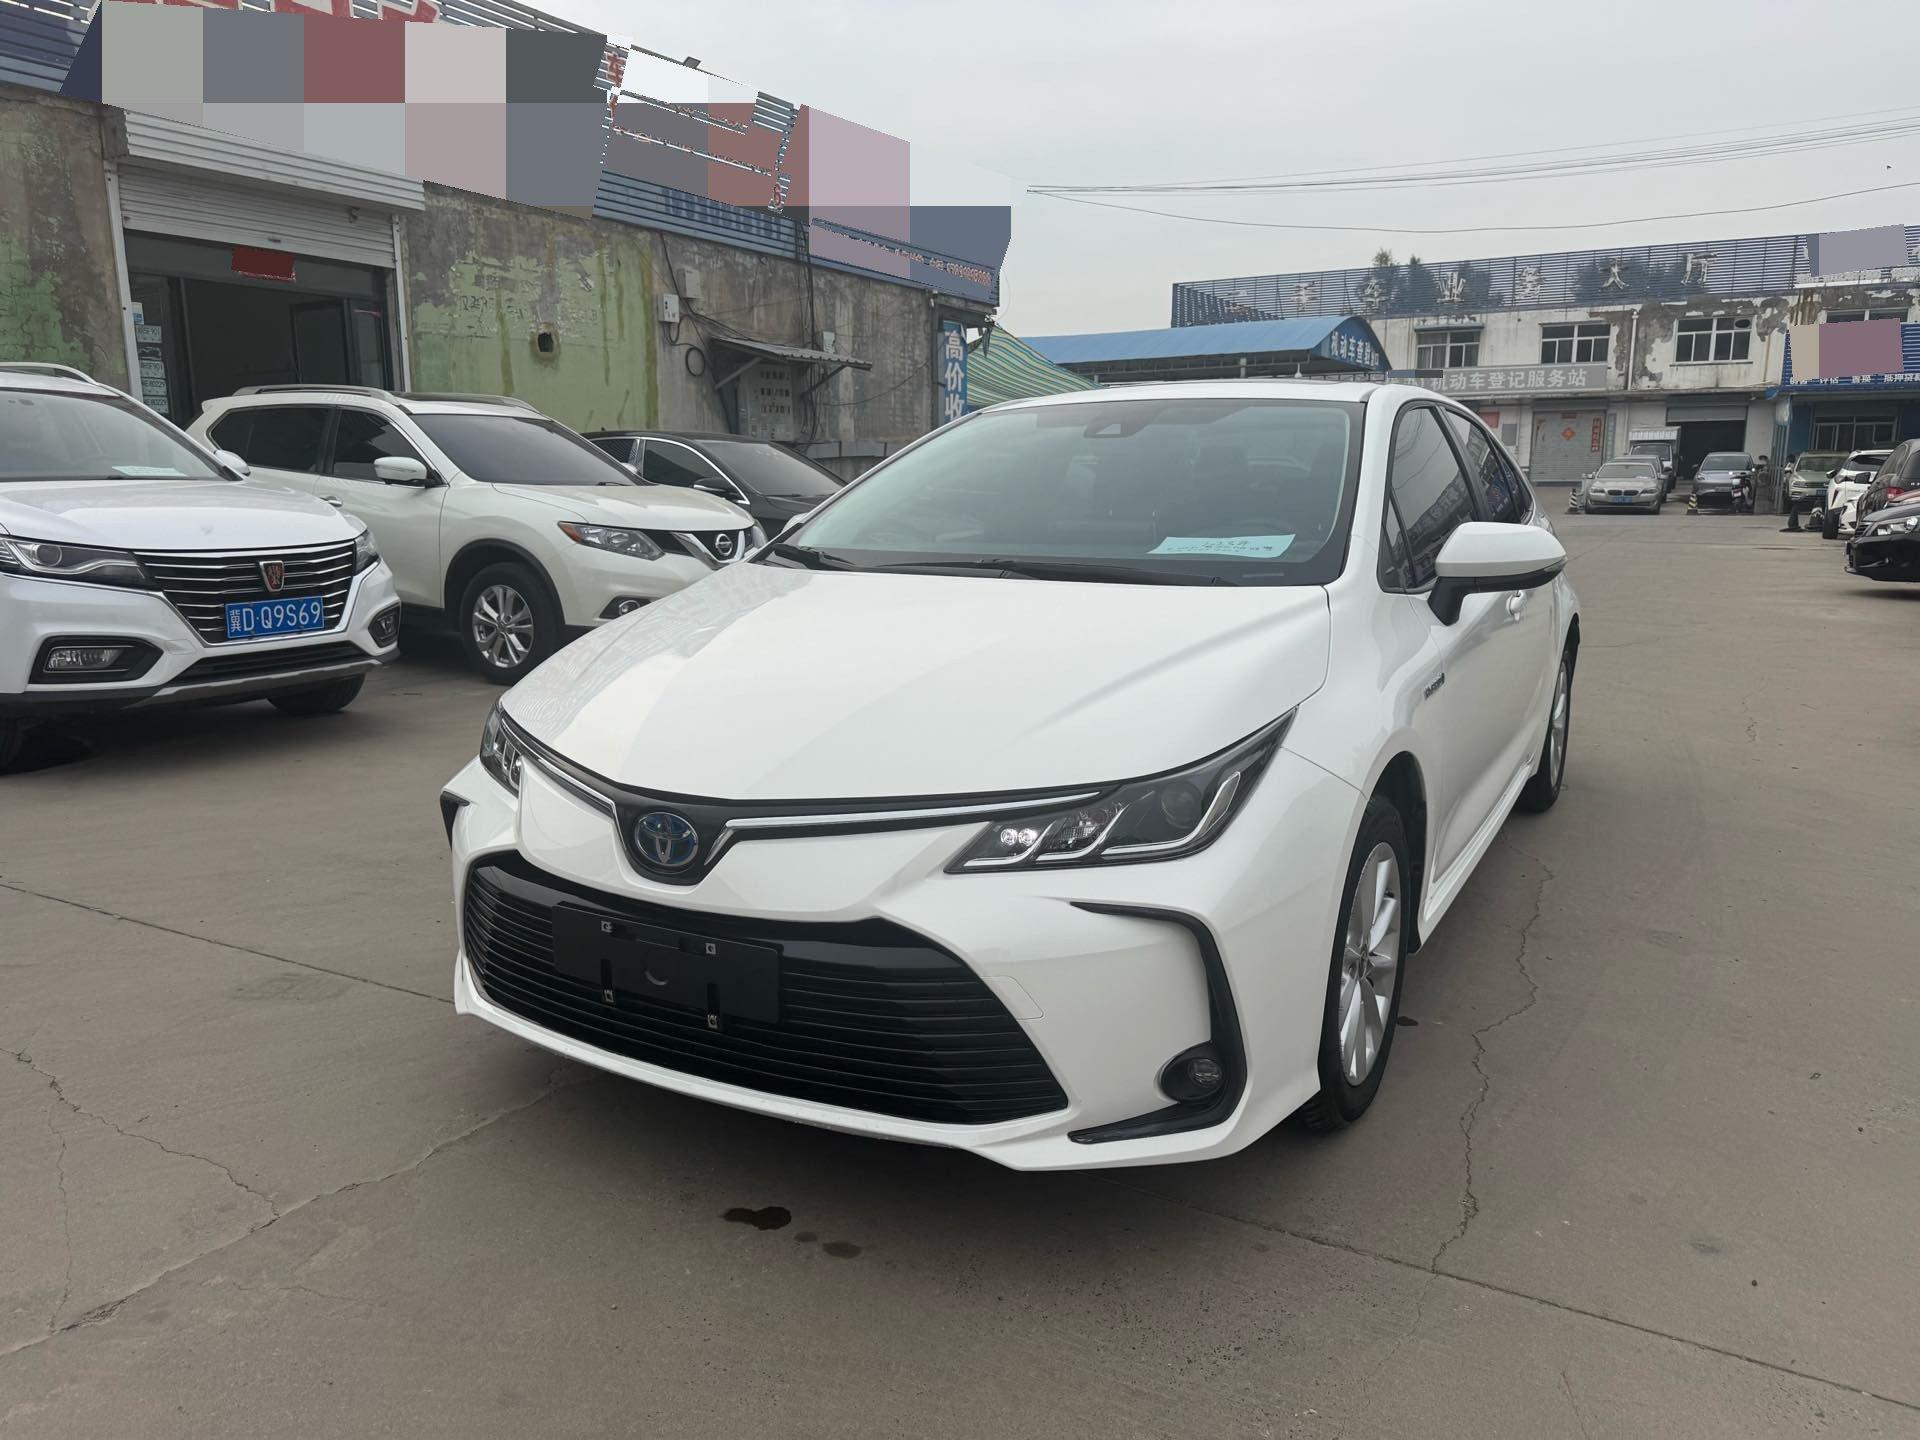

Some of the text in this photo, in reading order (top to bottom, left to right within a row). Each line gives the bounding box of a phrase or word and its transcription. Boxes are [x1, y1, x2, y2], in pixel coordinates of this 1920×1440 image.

[1388, 369, 1588, 391] 机动车登记服务站
